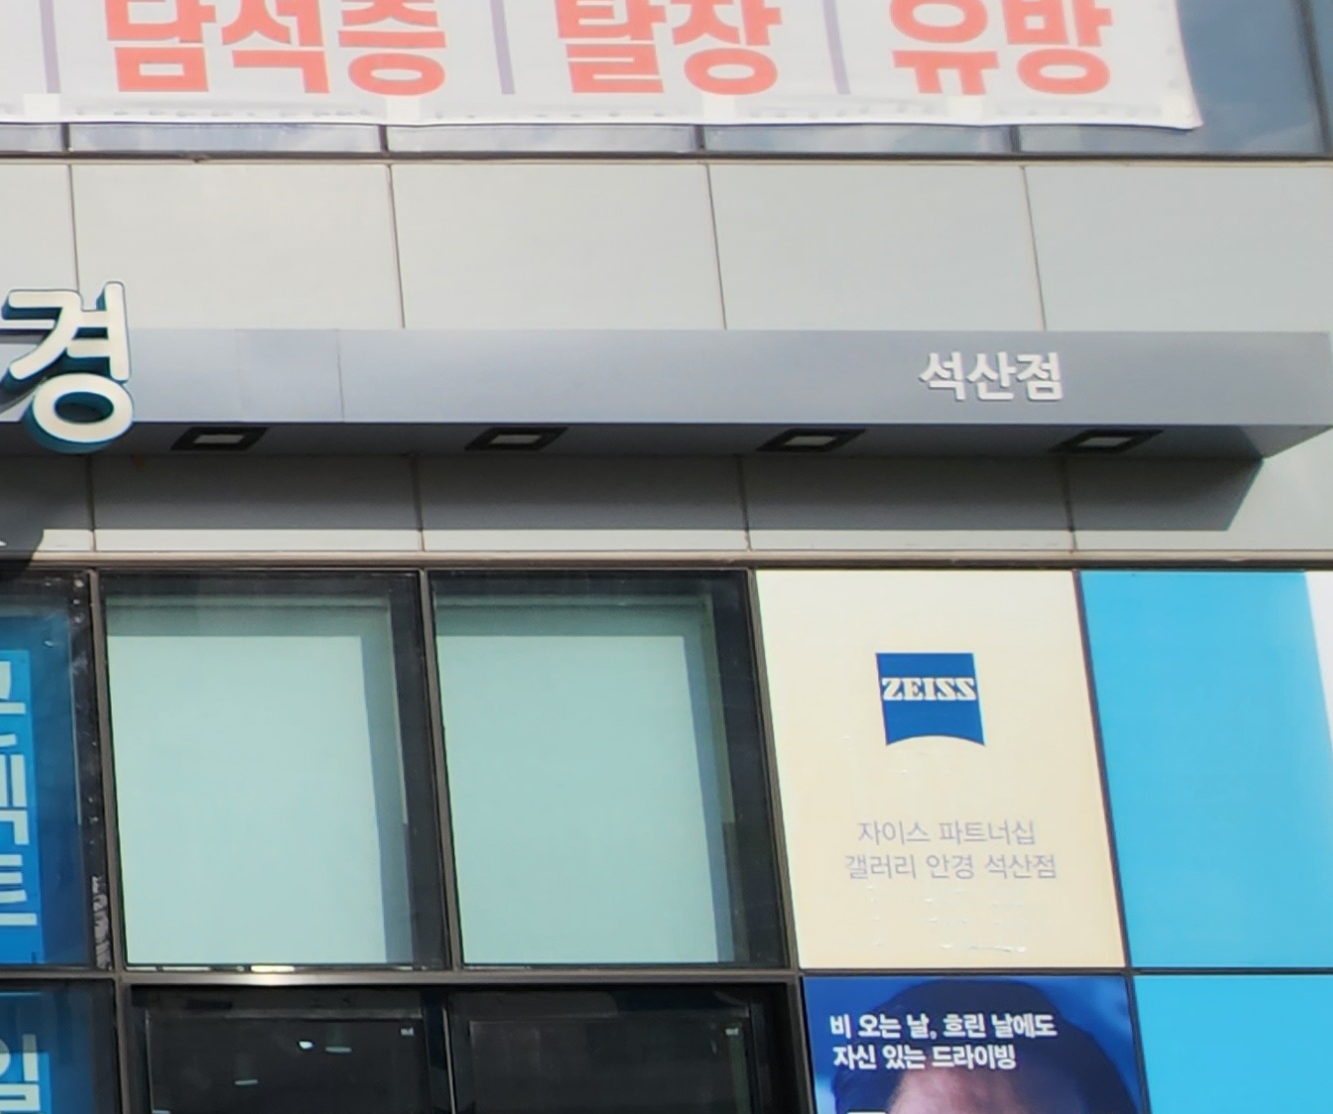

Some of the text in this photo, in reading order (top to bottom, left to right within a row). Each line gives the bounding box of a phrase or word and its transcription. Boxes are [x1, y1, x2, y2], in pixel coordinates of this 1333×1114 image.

[919, 351, 1064, 402] 석산점
[882, 677, 978, 701] ZEISS
[857, 820, 1037, 846] 자이스 파트너십
[845, 854, 1057, 880] 갤러리 안경 석산점
[829, 1014, 852, 1039] 비
[858, 1014, 902, 1037] 오는
[943, 1013, 987, 1037] 흐린
[992, 1012, 1058, 1039] 날에도
[833, 1044, 1017, 1070] 자신 있는 드라이빙
